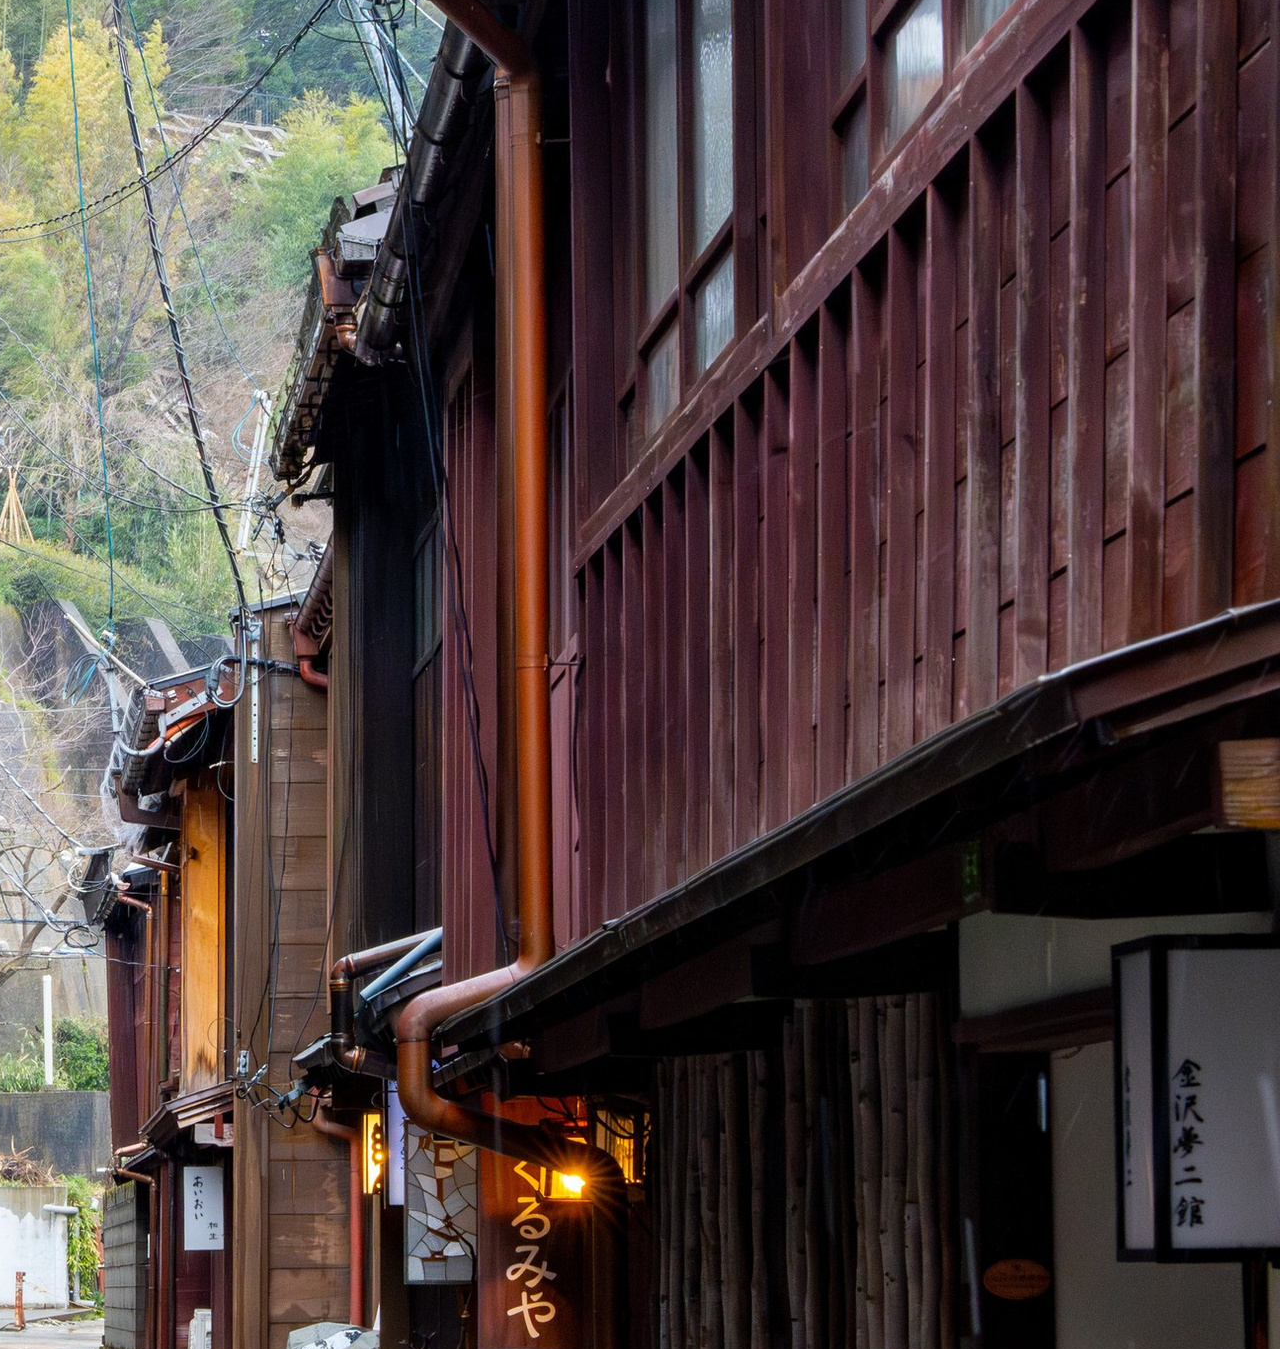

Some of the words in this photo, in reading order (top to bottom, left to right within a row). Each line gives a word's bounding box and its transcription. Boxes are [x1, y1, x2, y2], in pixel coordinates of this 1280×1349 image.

[192, 1175, 204, 1221] あいおい
[1172, 1058, 1206, 1228] 金沢夢二館
[505, 1160, 558, 1339] くるみや
